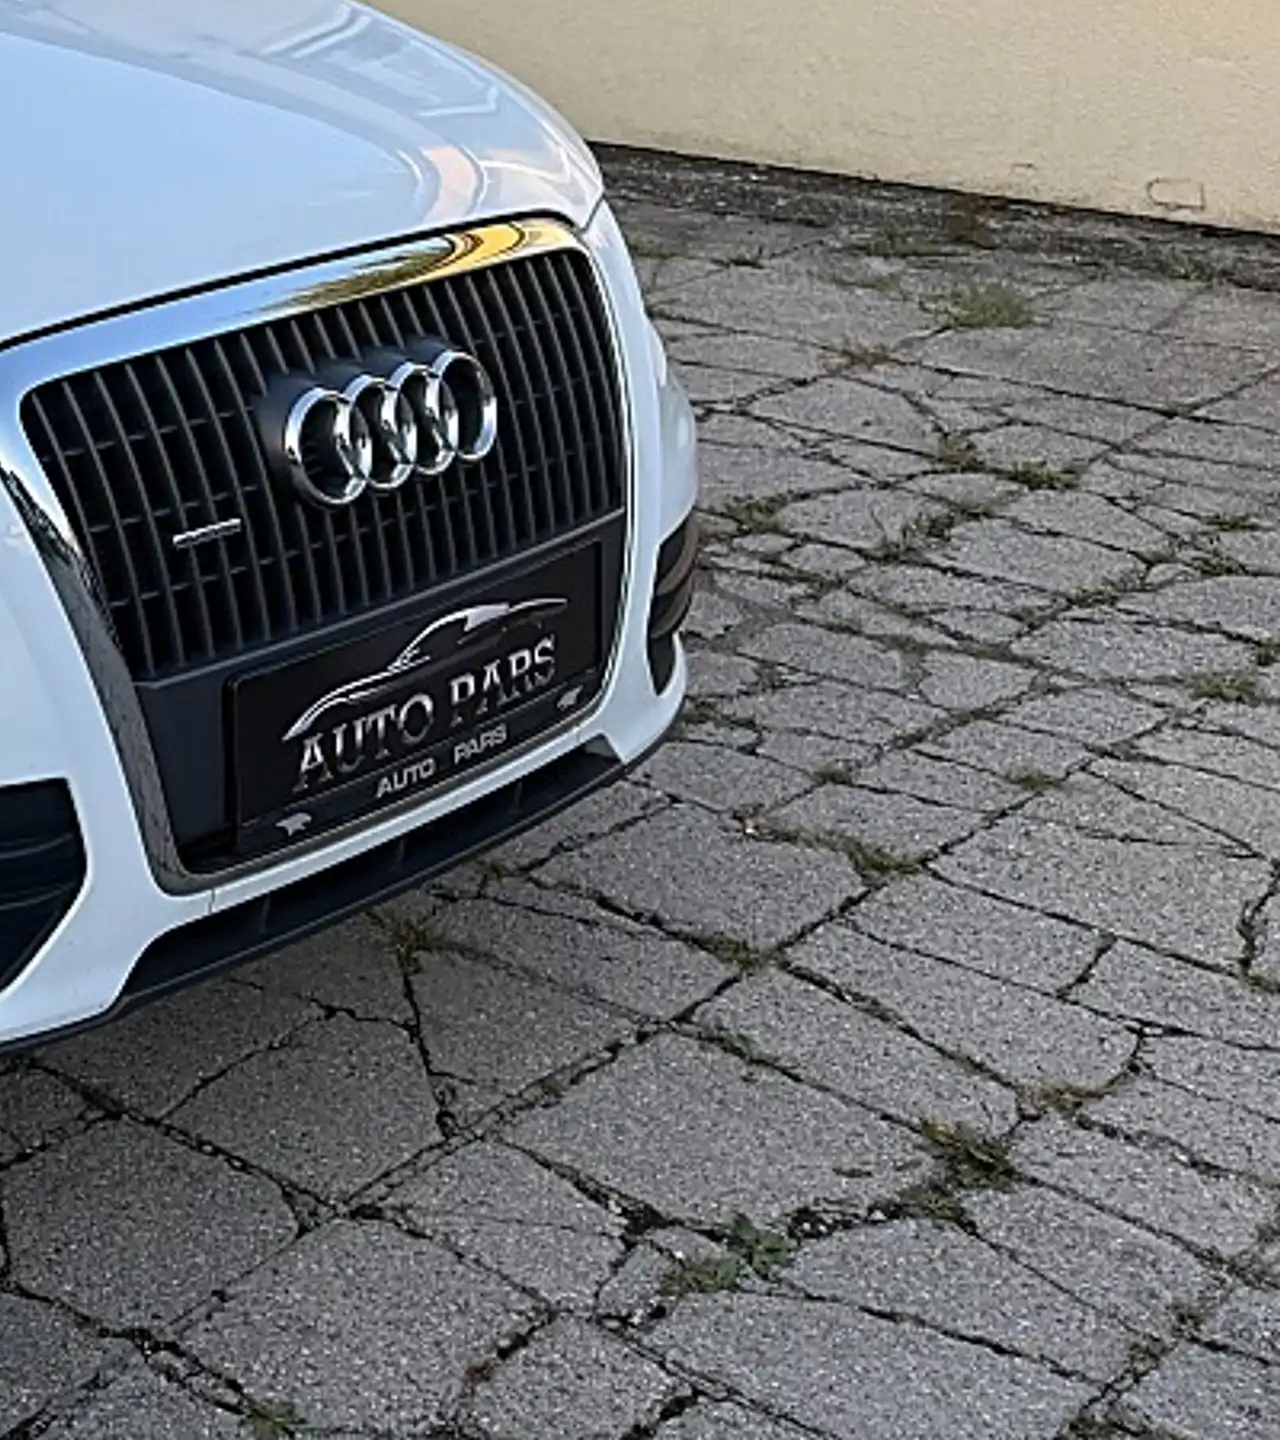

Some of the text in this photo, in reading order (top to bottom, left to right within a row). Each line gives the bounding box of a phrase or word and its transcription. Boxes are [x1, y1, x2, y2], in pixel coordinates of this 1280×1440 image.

[292, 632, 556, 792] AUTO PARS
[375, 722, 508, 799] AUTO PARS
